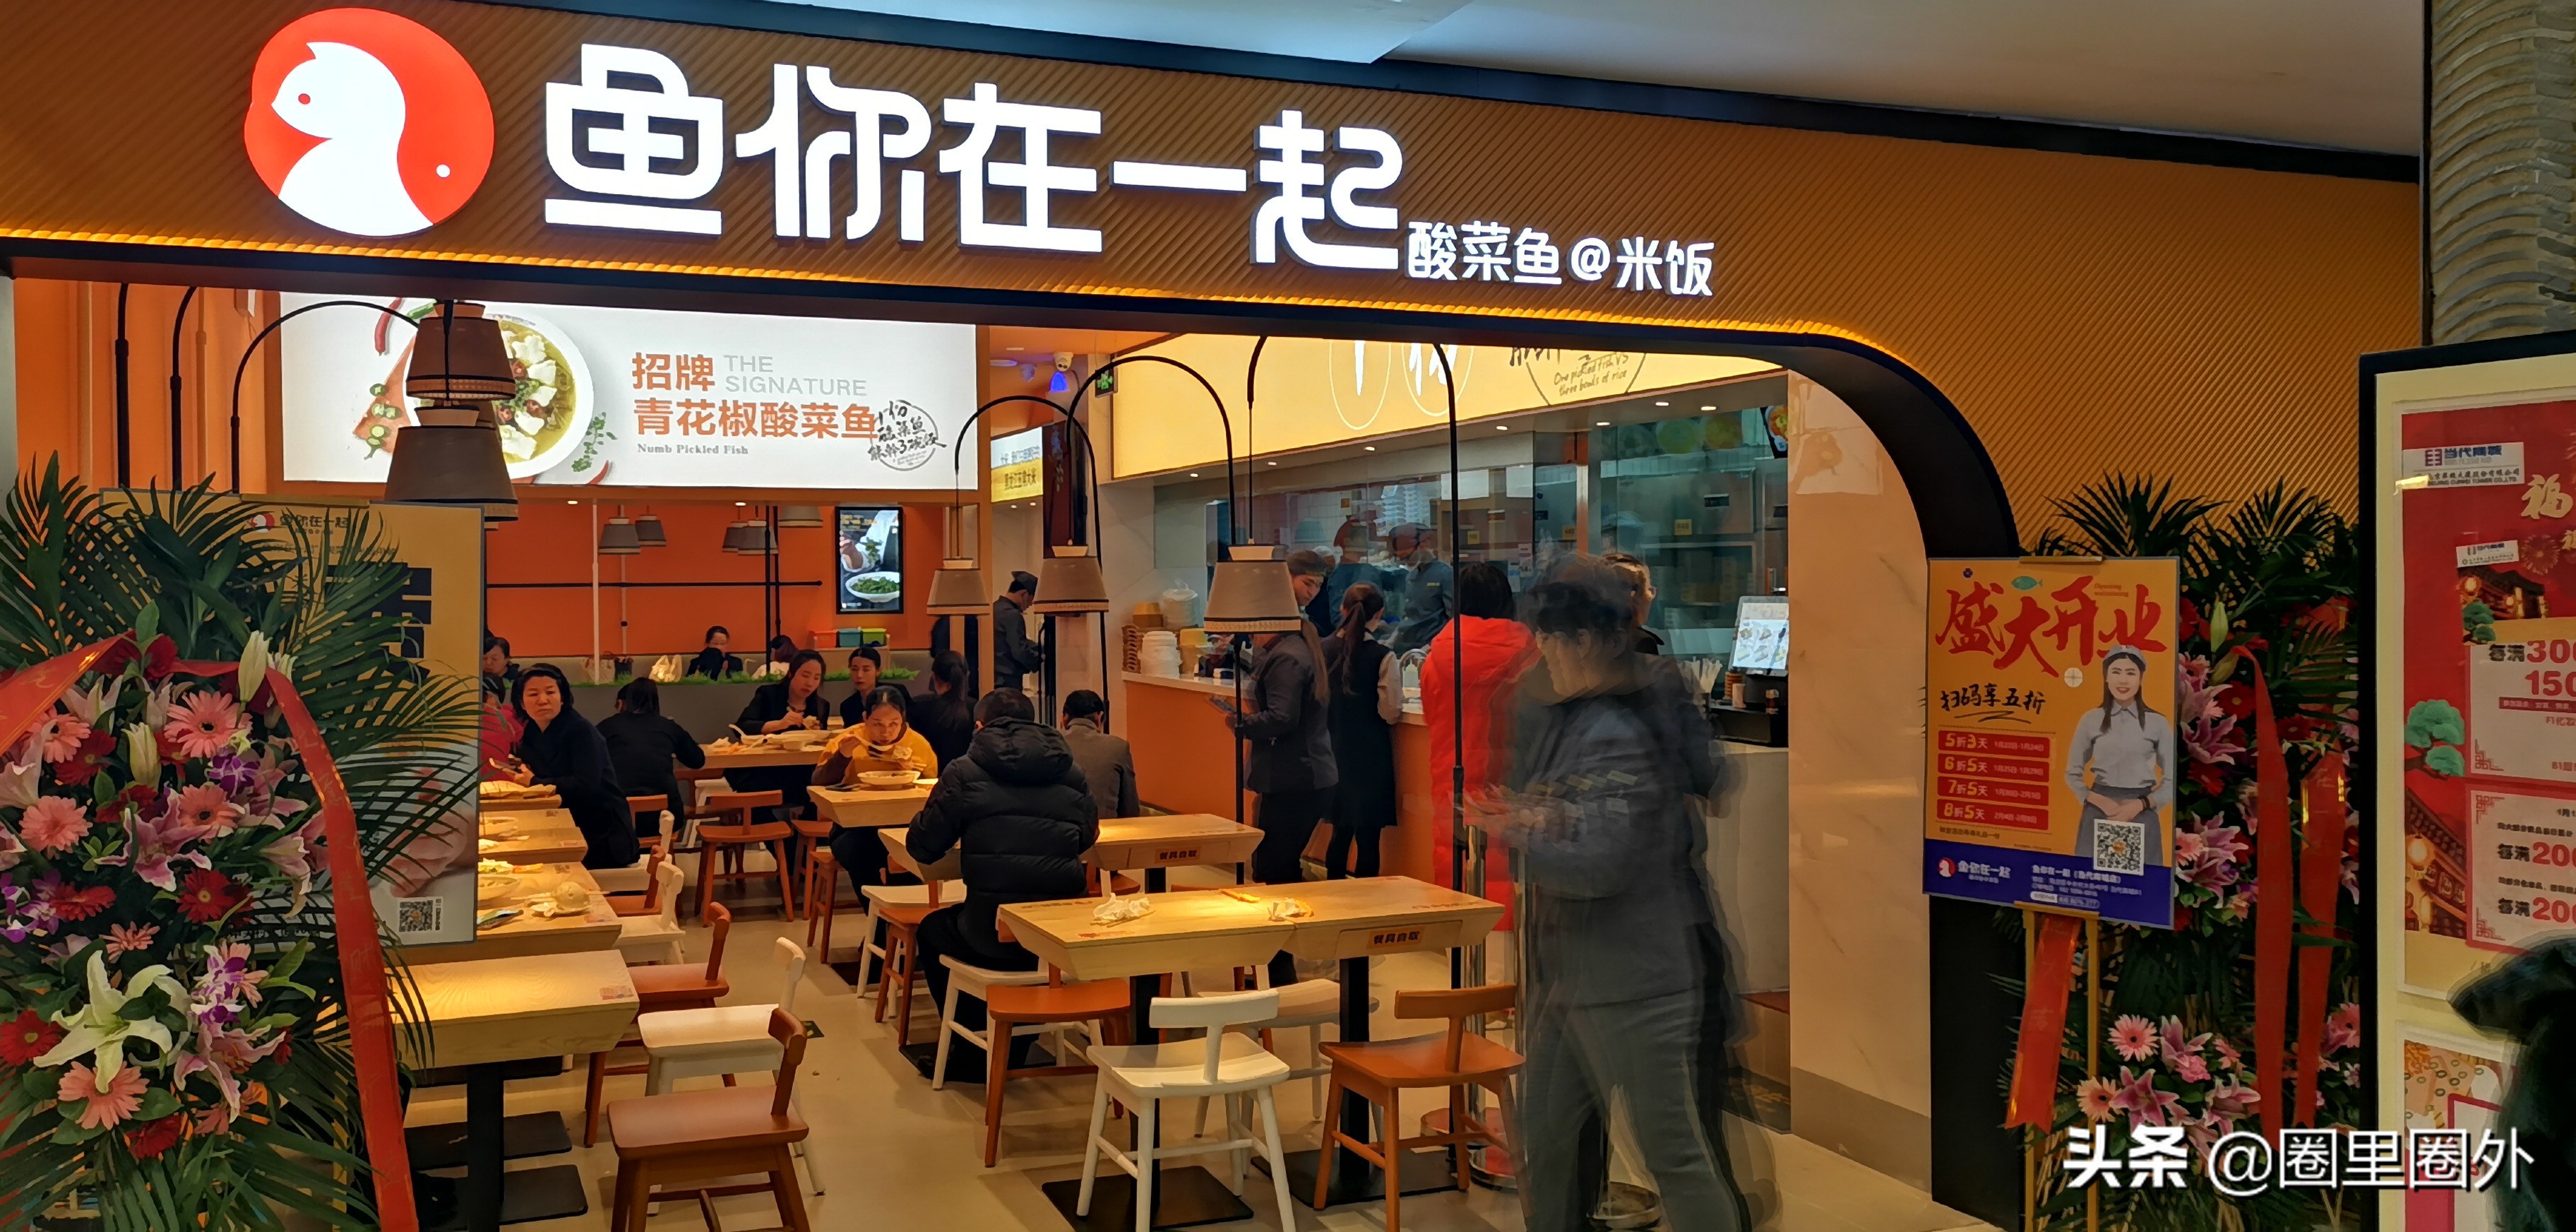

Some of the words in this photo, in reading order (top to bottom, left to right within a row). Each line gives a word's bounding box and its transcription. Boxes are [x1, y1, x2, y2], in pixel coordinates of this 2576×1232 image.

[544, 42, 1400, 271] 鱼你在一起
[632, 352, 715, 391] 招牌
[723, 354, 773, 372] THE
[725, 375, 867, 396] SIGNATURE
[633, 397, 878, 439] 青花椒酸菜鱼
[637, 443, 672, 454] Numb
[676, 444, 719, 454] Pickled
[724, 445, 749, 455] Fish
[2520, 473, 2574, 520] 福
[1935, 575, 2168, 678] 盛大开业
[1939, 682, 2046, 716] 扫码享五折
[1945, 733, 1988, 750] 5折3天
[1945, 756, 1988, 774] 6折5天
[1947, 779, 1988, 797] 7折5天
[1944, 802, 1986, 820] 8折5天
[2497, 841, 2576, 867] 每满20
[2498, 896, 2576, 924] 每满20
